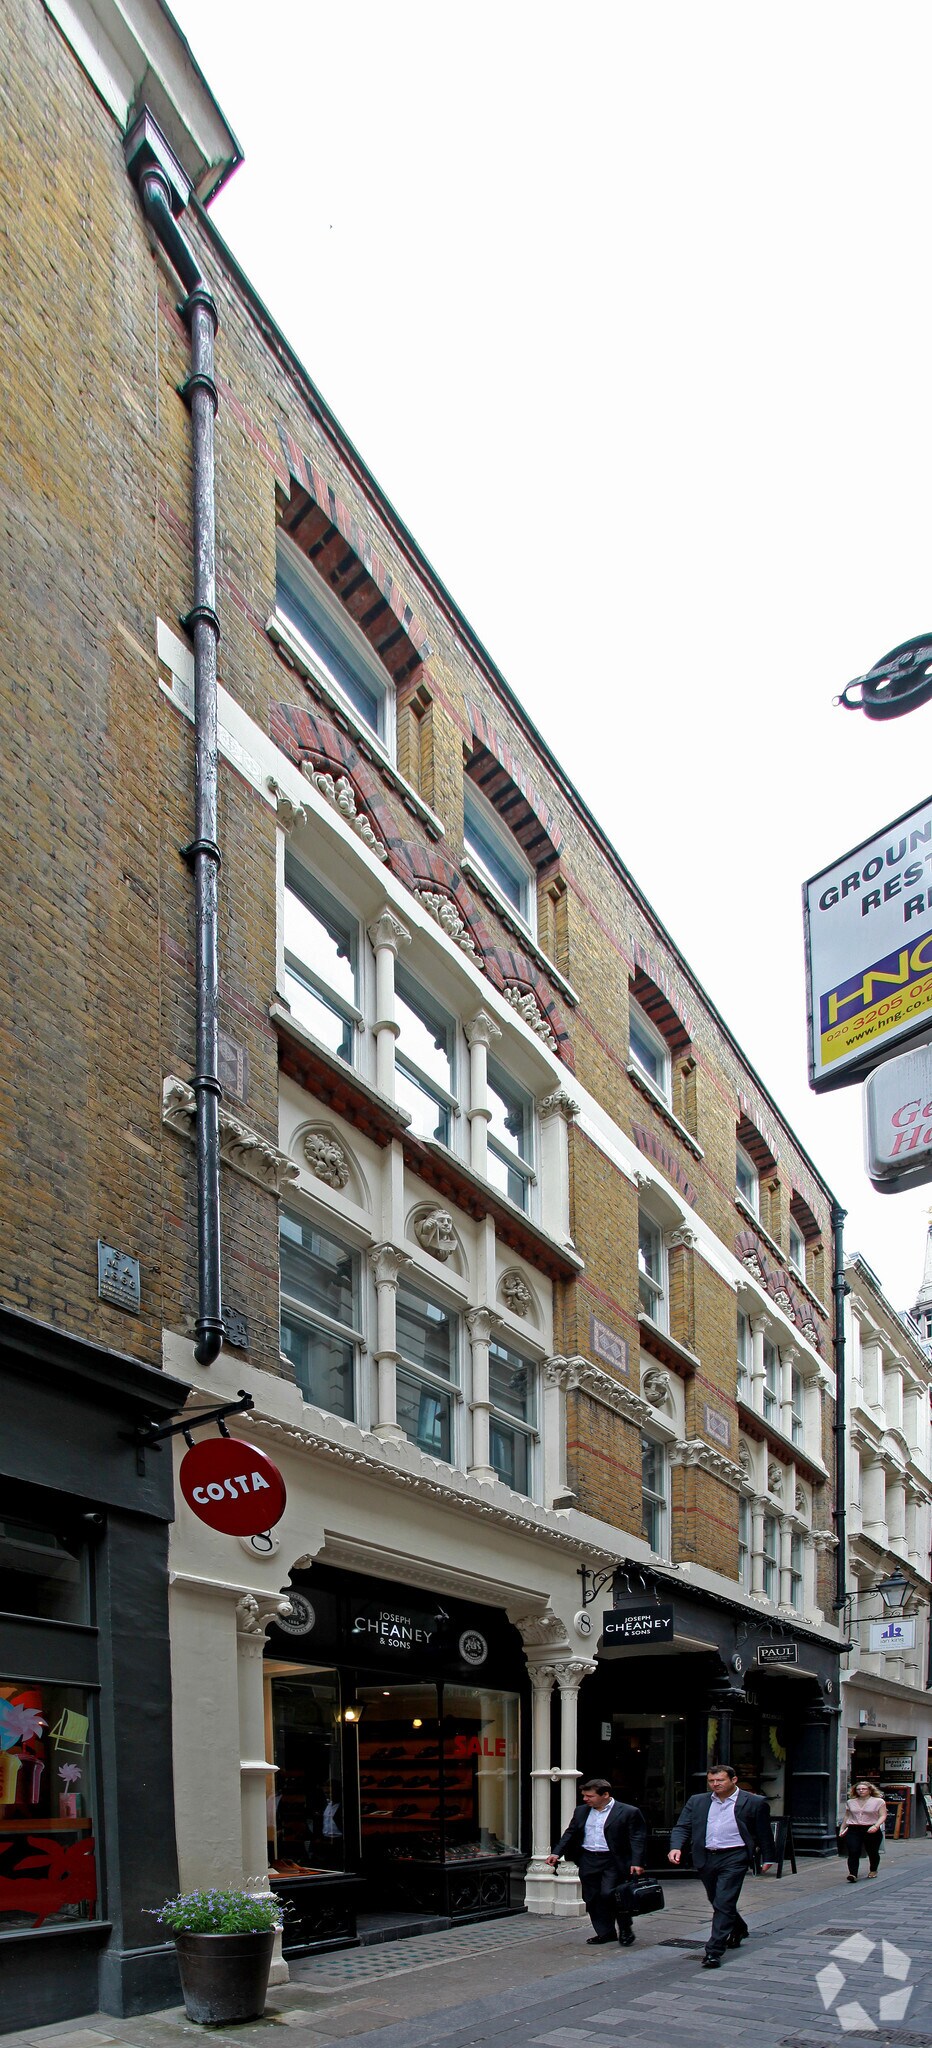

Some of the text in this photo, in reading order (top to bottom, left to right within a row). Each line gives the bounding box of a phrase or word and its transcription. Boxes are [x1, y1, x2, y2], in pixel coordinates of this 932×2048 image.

[903, 887, 932, 923] R
[826, 1026, 849, 1042] 020
[853, 995, 903, 1031] 3205
[192, 1471, 270, 1504] COSTA
[379, 1611, 411, 1625] JOSEPH
[580, 1614, 591, 1633] 8
[605, 1618, 671, 1633] CHEANEY
[624, 1615, 651, 1624] JOSEPH
[354, 1617, 432, 1643] CHEANEY
[380, 1637, 411, 1649] & SONS
[761, 1647, 793, 1657] PAUL
[735, 1656, 742, 1671] 6
[454, 1735, 506, 1757] SALE
